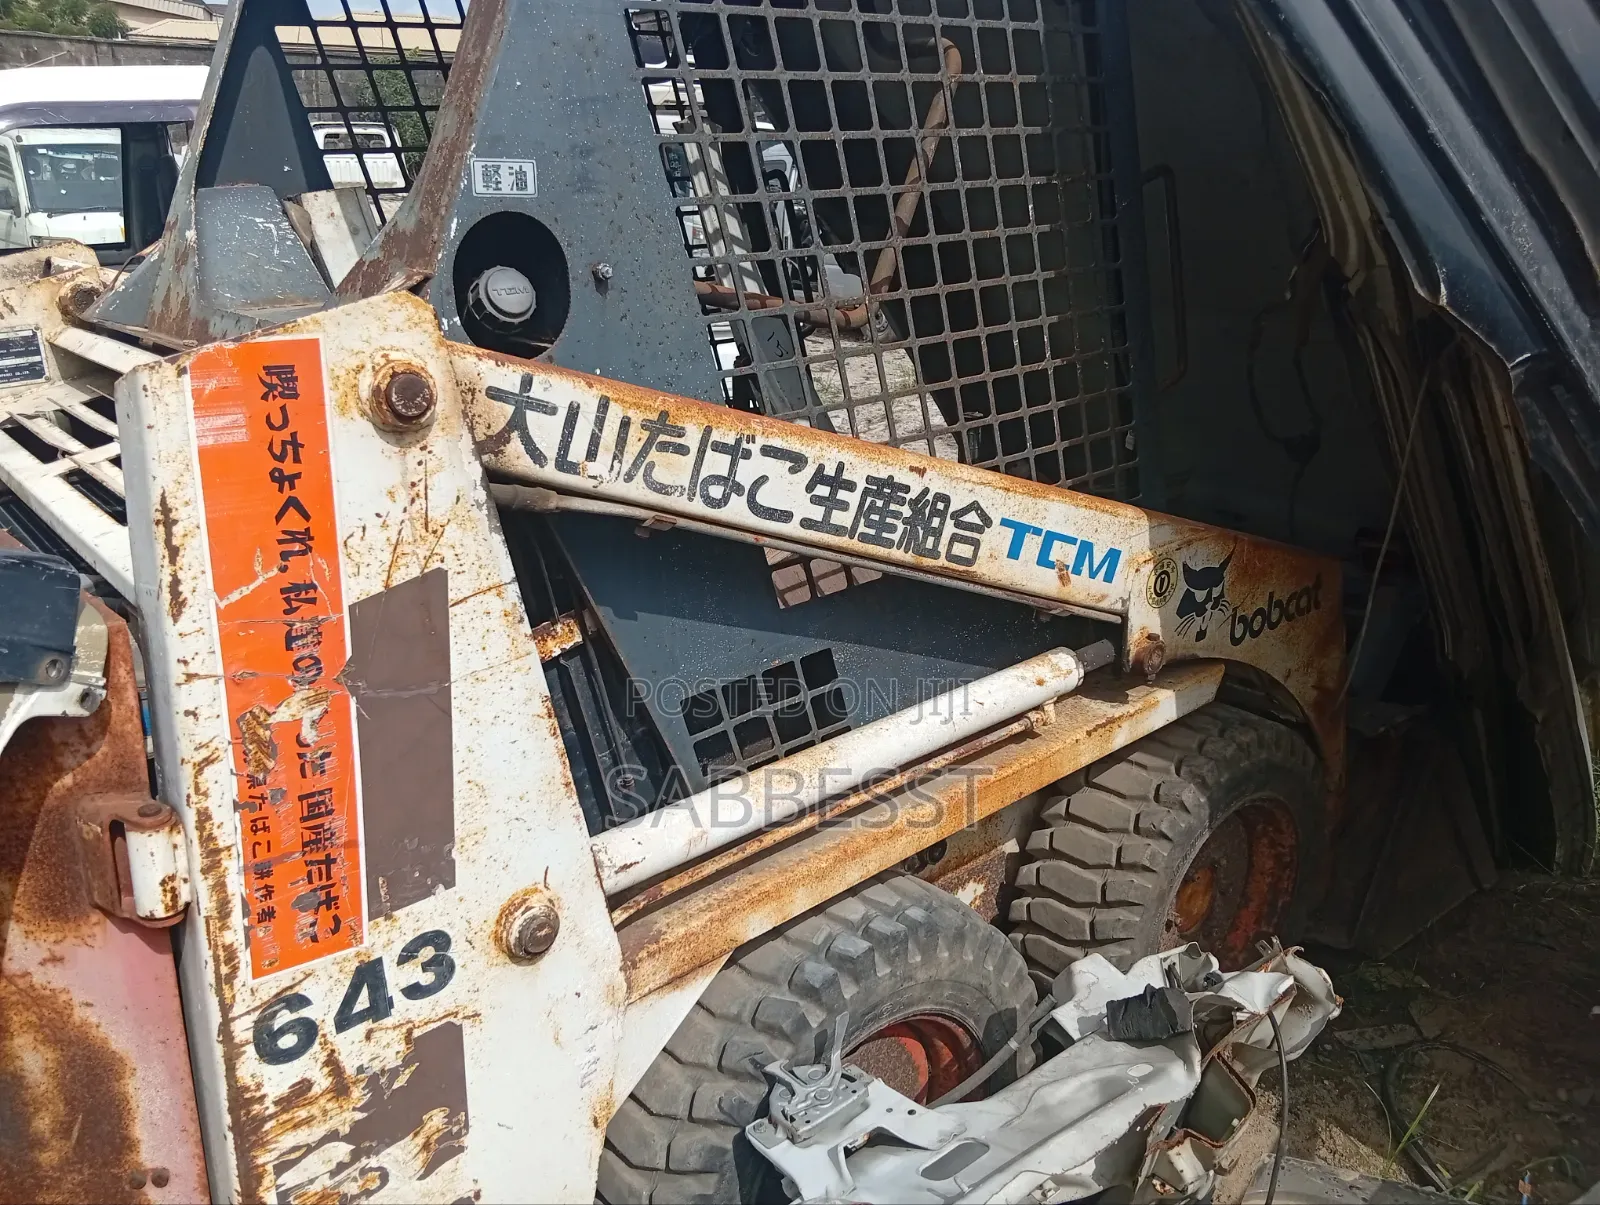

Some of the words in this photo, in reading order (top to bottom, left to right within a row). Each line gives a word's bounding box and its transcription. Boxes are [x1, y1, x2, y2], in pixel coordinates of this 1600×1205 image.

[482, 164, 529, 192] 軽油
[485, 372, 993, 568] 大山たばこ生産組合
[999, 516, 1122, 584] TCM
[1229, 572, 1324, 647] bobcat
[252, 928, 457, 1066] 643
